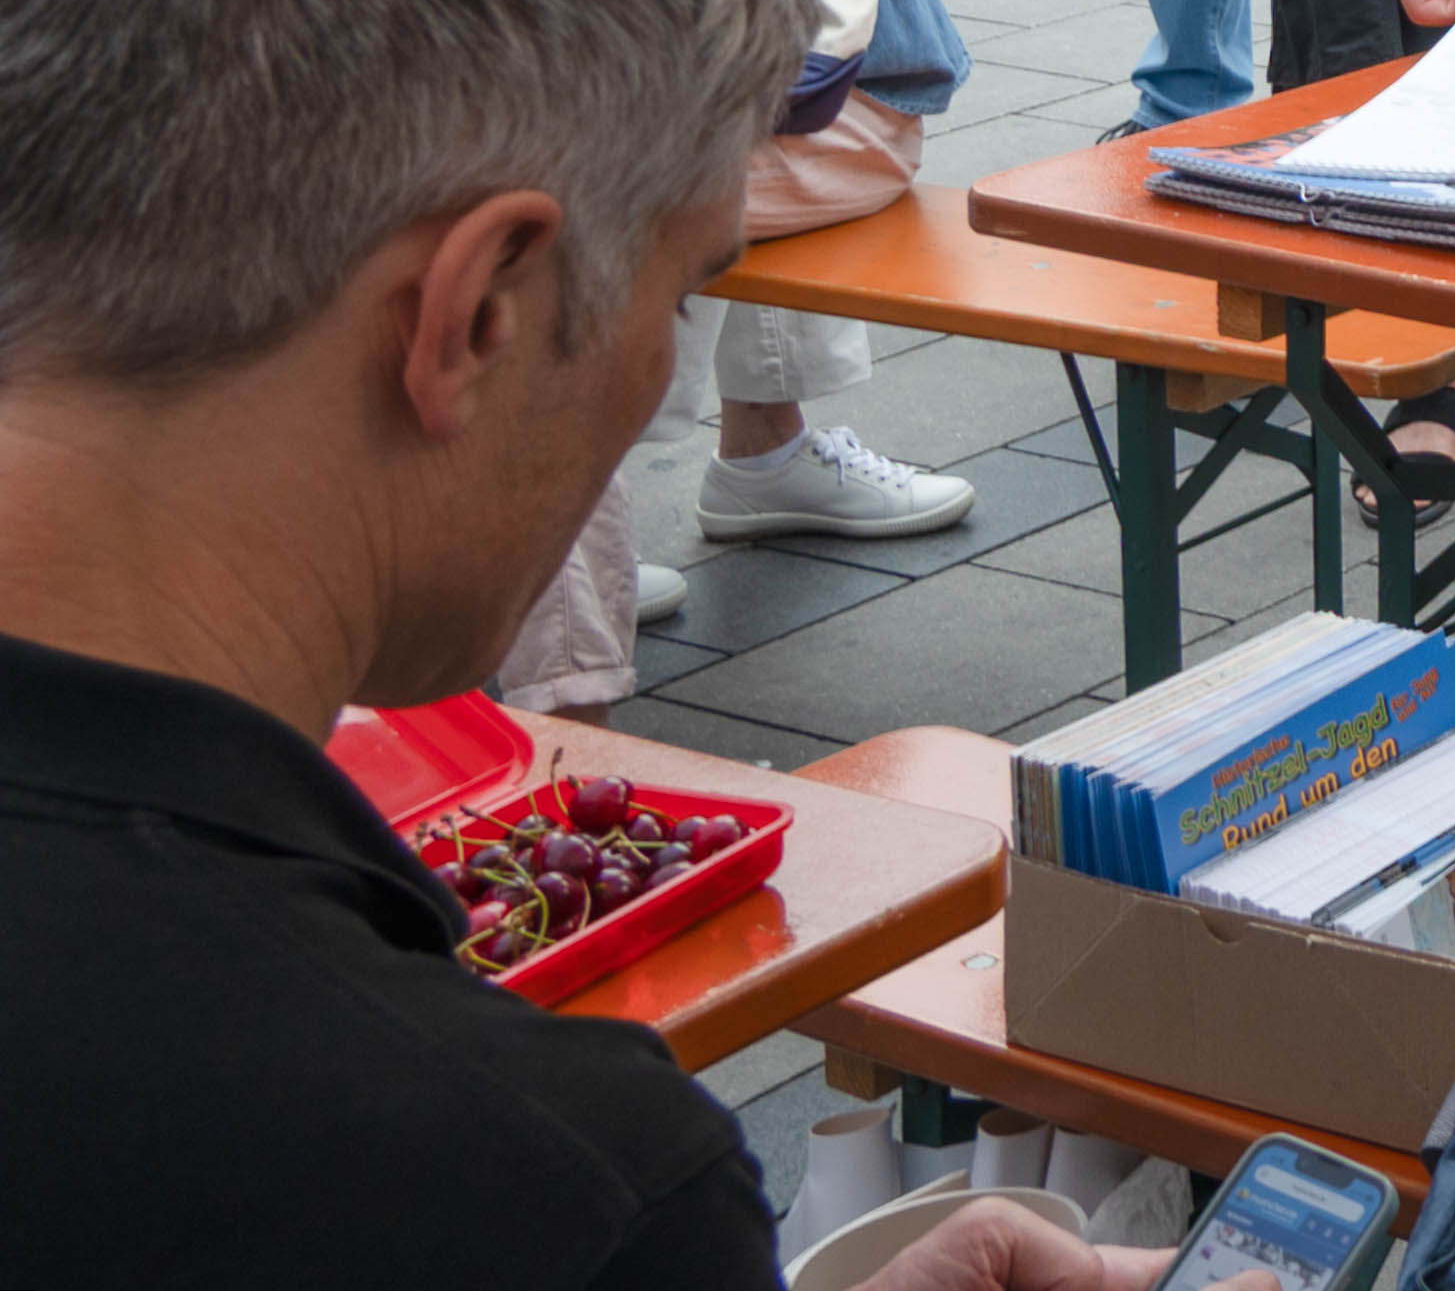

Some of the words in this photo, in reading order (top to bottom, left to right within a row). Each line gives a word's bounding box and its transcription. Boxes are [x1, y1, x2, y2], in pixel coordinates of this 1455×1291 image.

[1178, 693, 1390, 846] Schnitzel-Jagd
[1221, 795, 1289, 851] Rund
[1300, 770, 1340, 808] um
[1350, 737, 1398, 780] den
